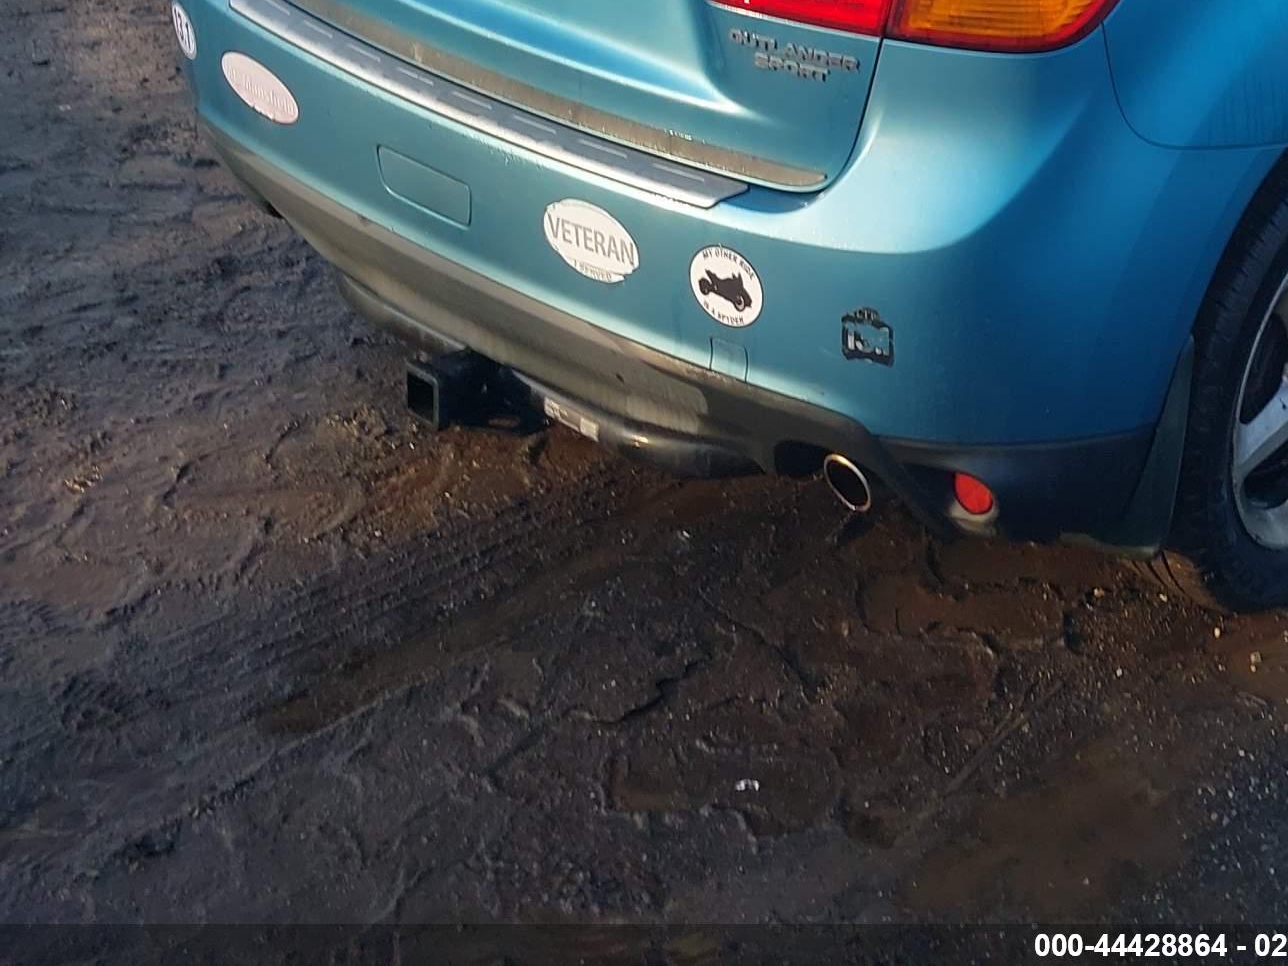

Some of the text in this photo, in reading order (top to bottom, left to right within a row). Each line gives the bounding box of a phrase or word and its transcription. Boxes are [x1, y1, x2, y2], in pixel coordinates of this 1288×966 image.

[730, 28, 862, 71] OUTLANDER
[754, 52, 831, 82] SPORT
[546, 212, 635, 267] VETERAN
